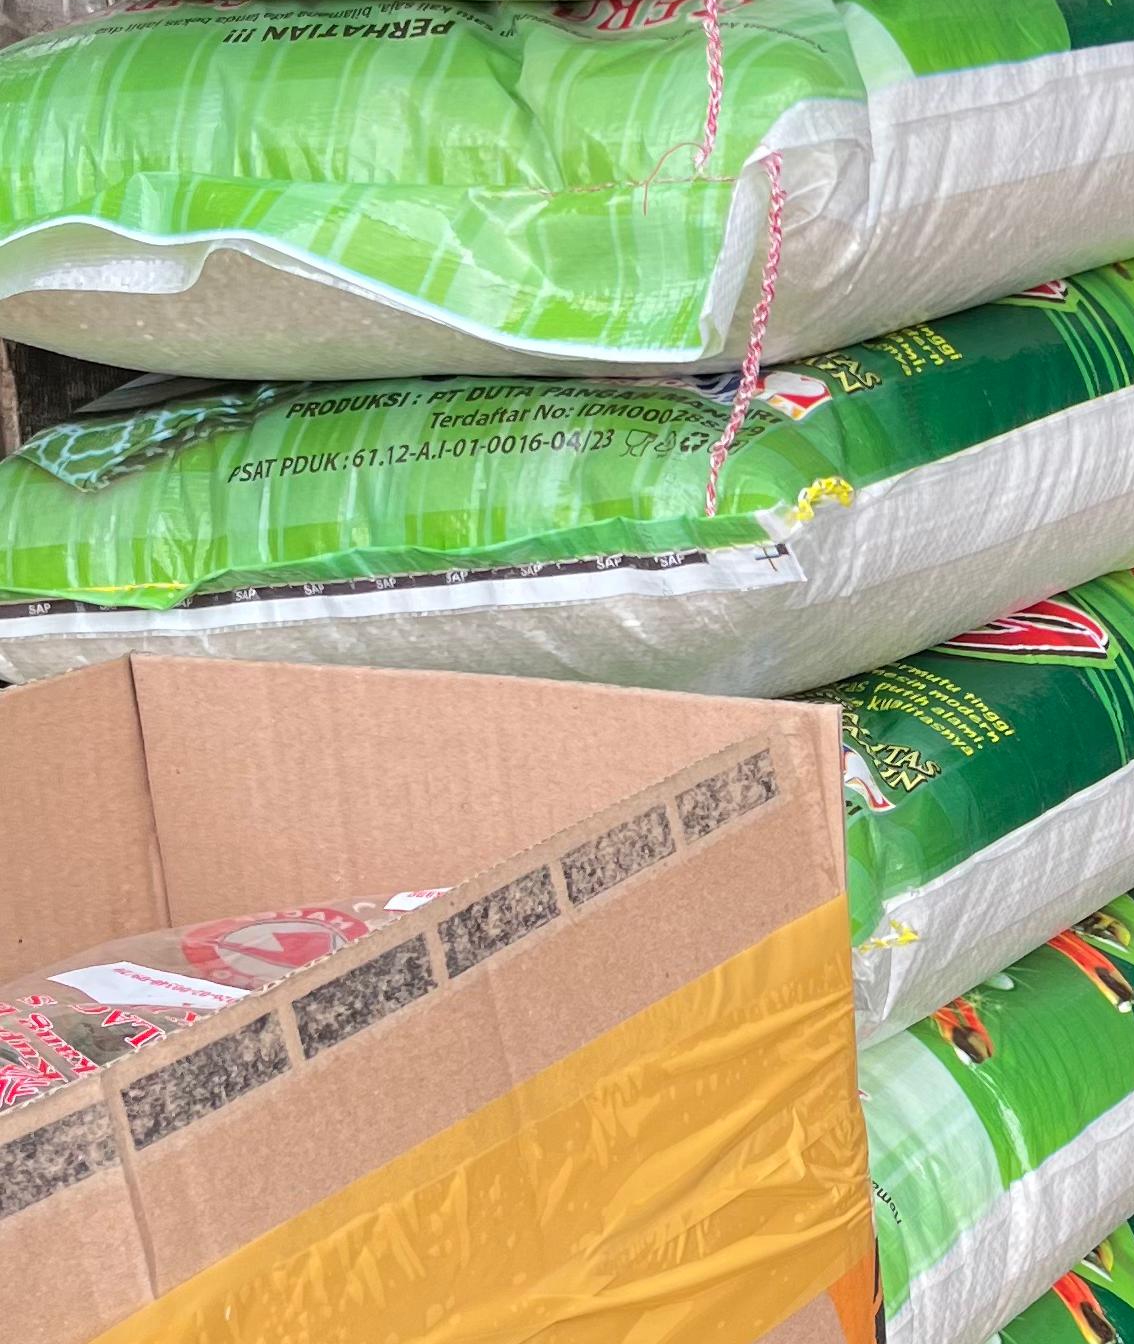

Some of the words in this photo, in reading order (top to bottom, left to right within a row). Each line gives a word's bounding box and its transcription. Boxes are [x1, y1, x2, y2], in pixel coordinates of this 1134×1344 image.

[261, 18, 457, 44] PERHATIAN
[286, 391, 411, 419] PRODUKSI
[427, 388, 465, 405] PT
[465, 384, 536, 402] DUTA
[430, 402, 538, 430] Terdaftar
[227, 457, 278, 484] PSAT
[279, 451, 340, 478] PDUK
[28, 602, 52, 616] SAP
[235, 588, 257, 602] SAP
[304, 583, 326, 597] SAP
[376, 577, 398, 591] SAP
[596, 555, 623, 570] SAP
[659, 554, 686, 568] SAP
[873, 681, 930, 707] putih
[928, 688, 1001, 744] modern
[963, 691, 1016, 738] tinggi
